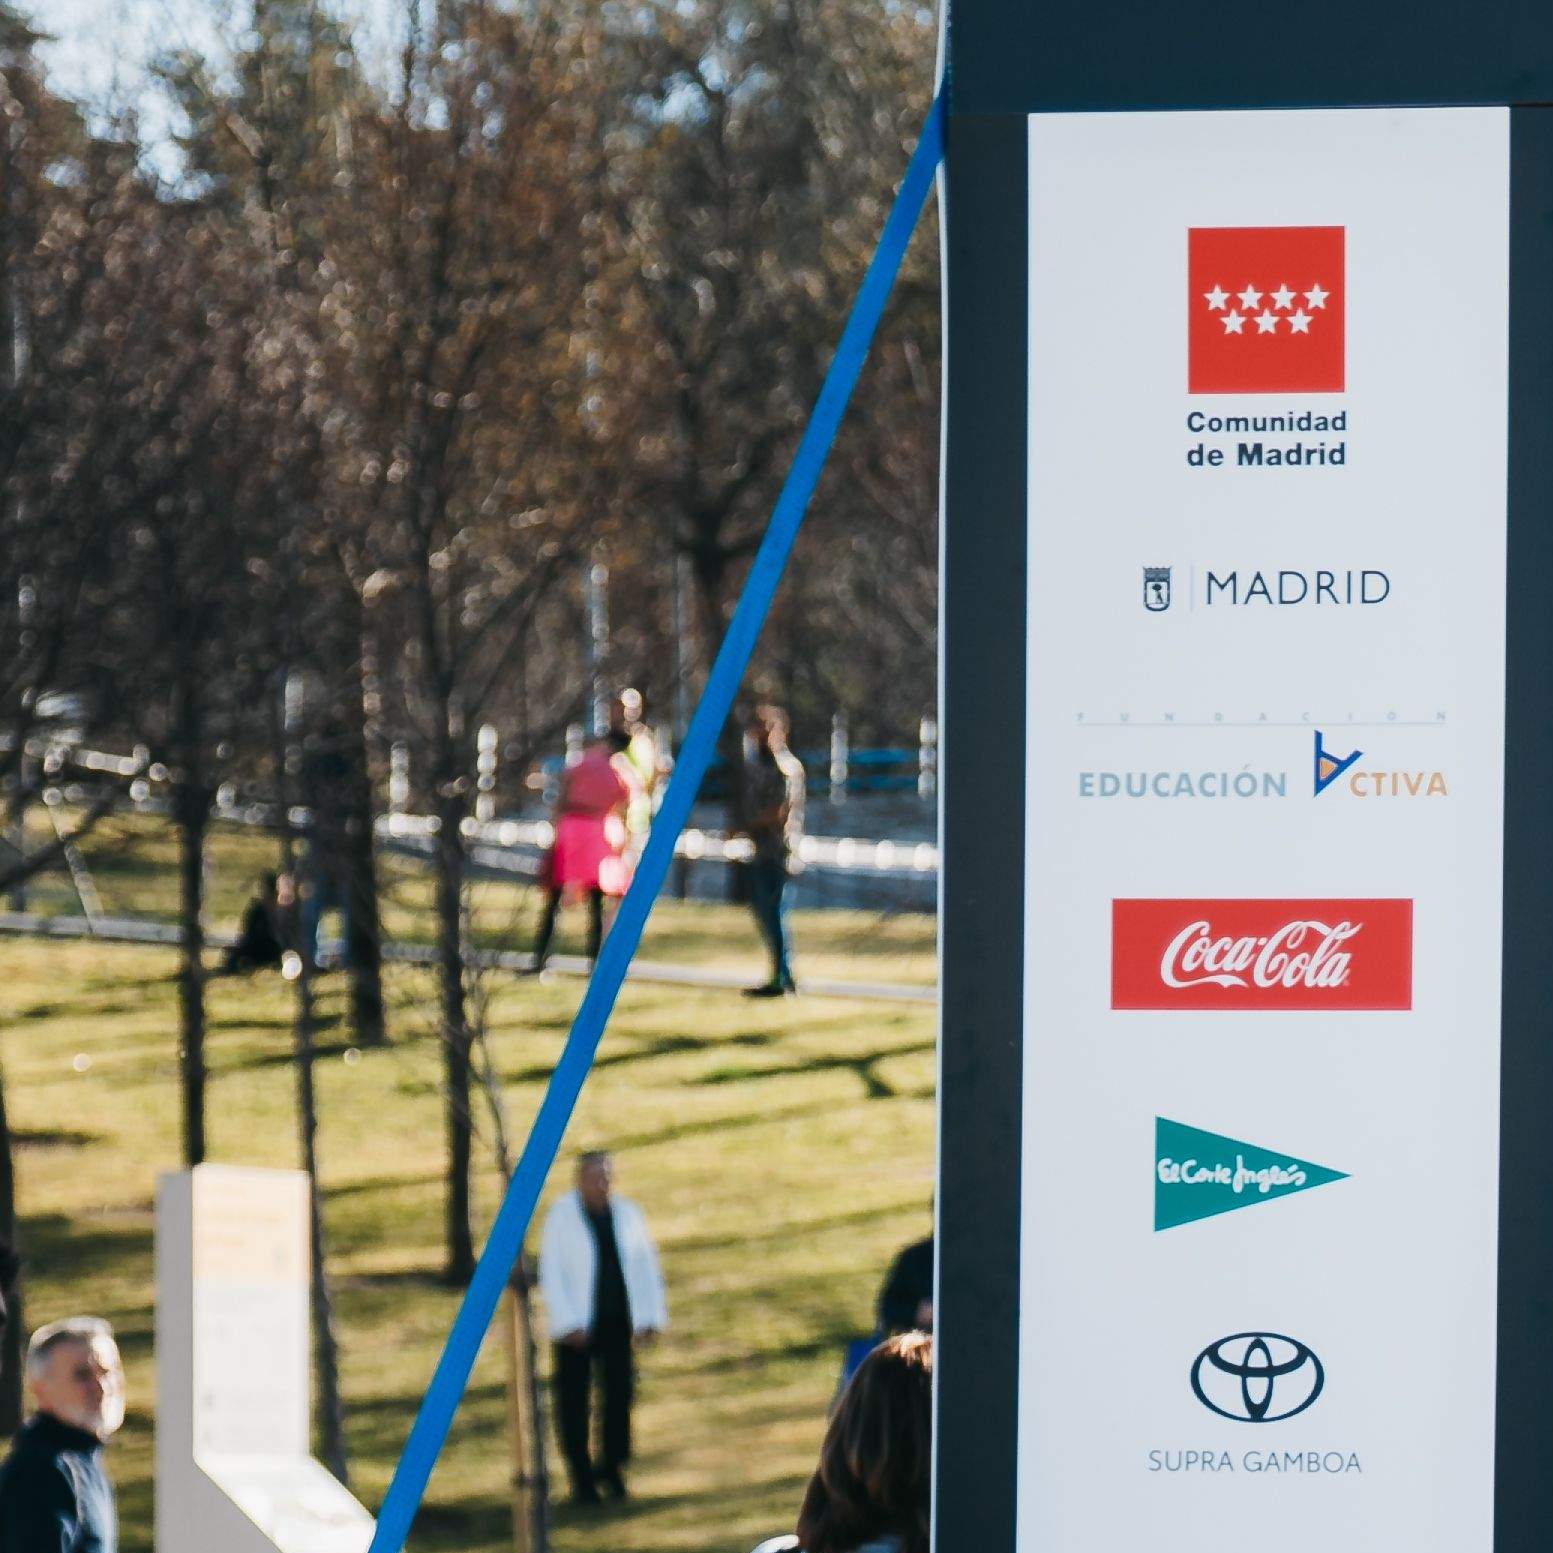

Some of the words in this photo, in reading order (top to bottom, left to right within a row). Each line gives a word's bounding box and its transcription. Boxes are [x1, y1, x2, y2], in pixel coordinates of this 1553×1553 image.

[1186, 410, 1347, 433] Comunidad
[1186, 442, 1224, 467] de
[1236, 442, 1347, 467] Madrid
[1205, 569, 1391, 606] MADRID
[1079, 763, 1287, 799] EDUCACIÓN
[1159, 919, 1364, 989] Coca-Cola
[1148, 1450, 1235, 1474] SUPRA
[1242, 1451, 1363, 1475] GAMBOA
